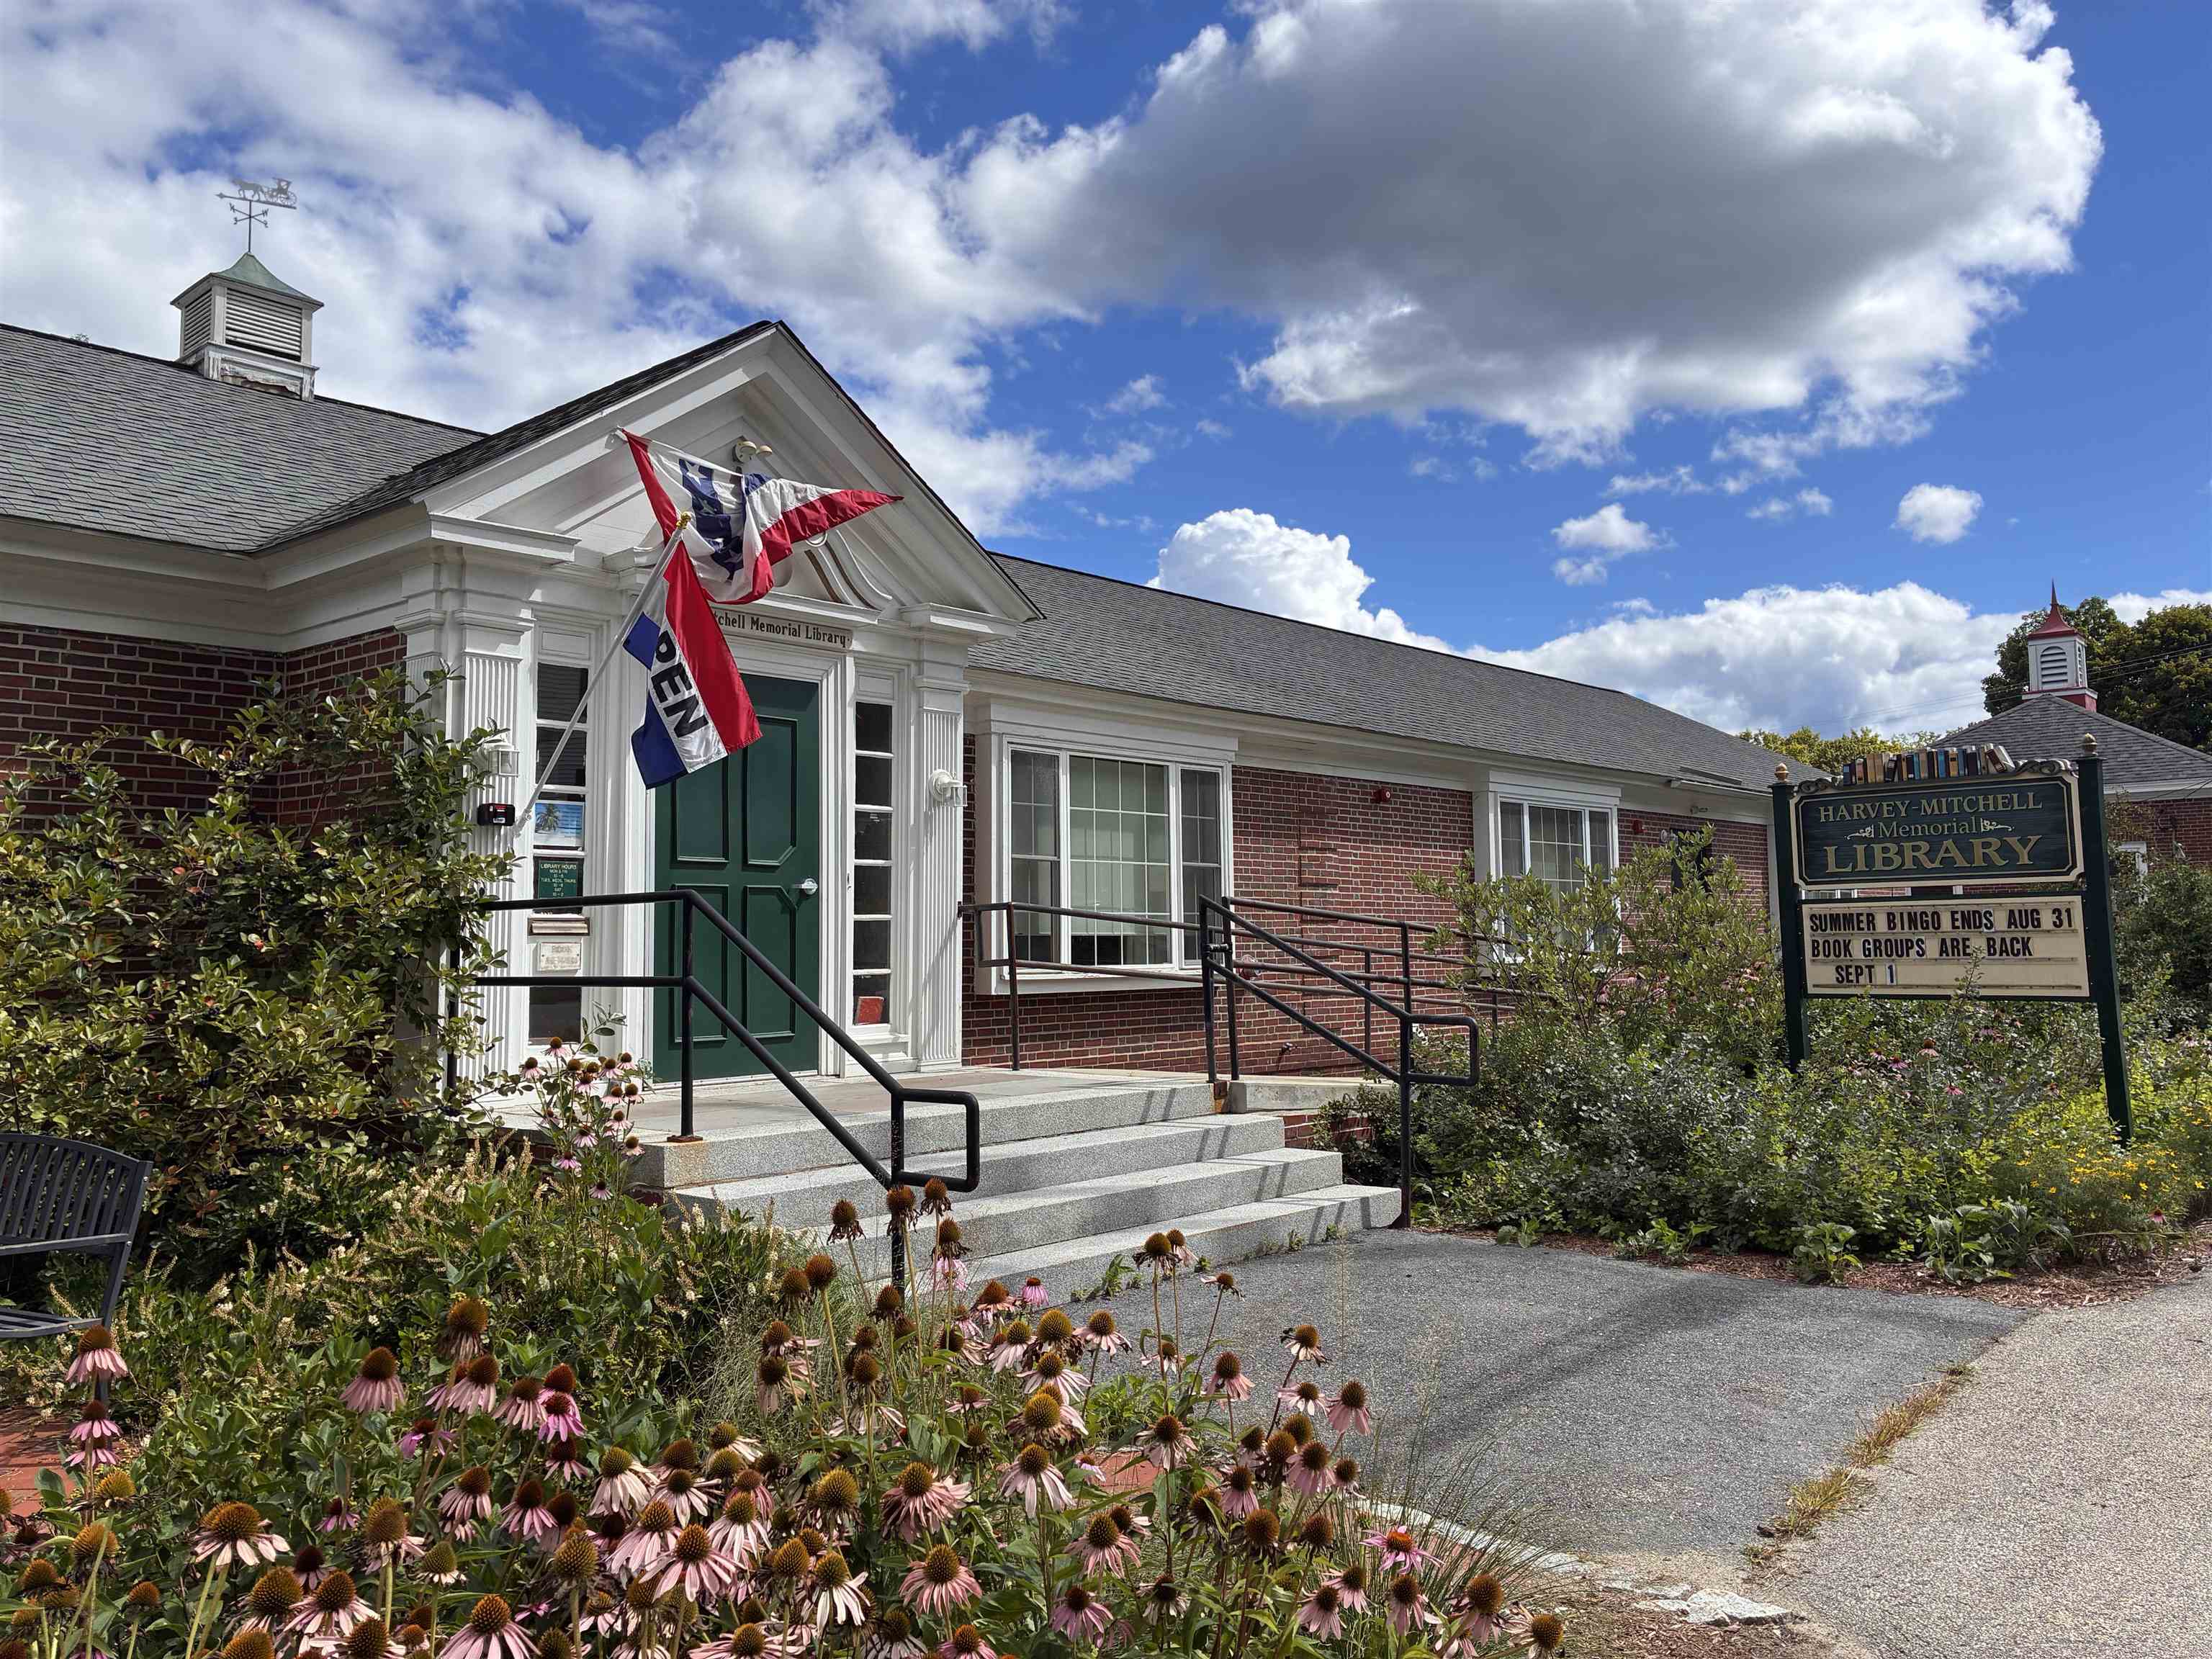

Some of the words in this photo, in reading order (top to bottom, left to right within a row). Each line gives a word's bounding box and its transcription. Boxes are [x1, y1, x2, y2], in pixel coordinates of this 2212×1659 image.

[714, 611, 745, 629] chell
[750, 616, 801, 638] Memorial
[651, 629, 709, 738] PEN
[1878, 817, 1978, 839] Memorial
[1823, 835, 2043, 873] LIBRARY
[1809, 912, 1876, 932] SUMMER
[1887, 911, 1941, 931] BINGO
[1951, 910, 1994, 931] ENDS
[2007, 909, 2041, 930] AUG
[2052, 907, 2073, 929] 31
[1811, 939, 1853, 958] BOOK
[1862, 938, 1925, 958] GROUPS
[1939, 937, 1972, 957] ARE
[1987, 937, 2033, 957] BACK
[1835, 965, 1874, 984] SEPT
[1887, 964, 1894, 984] 1
